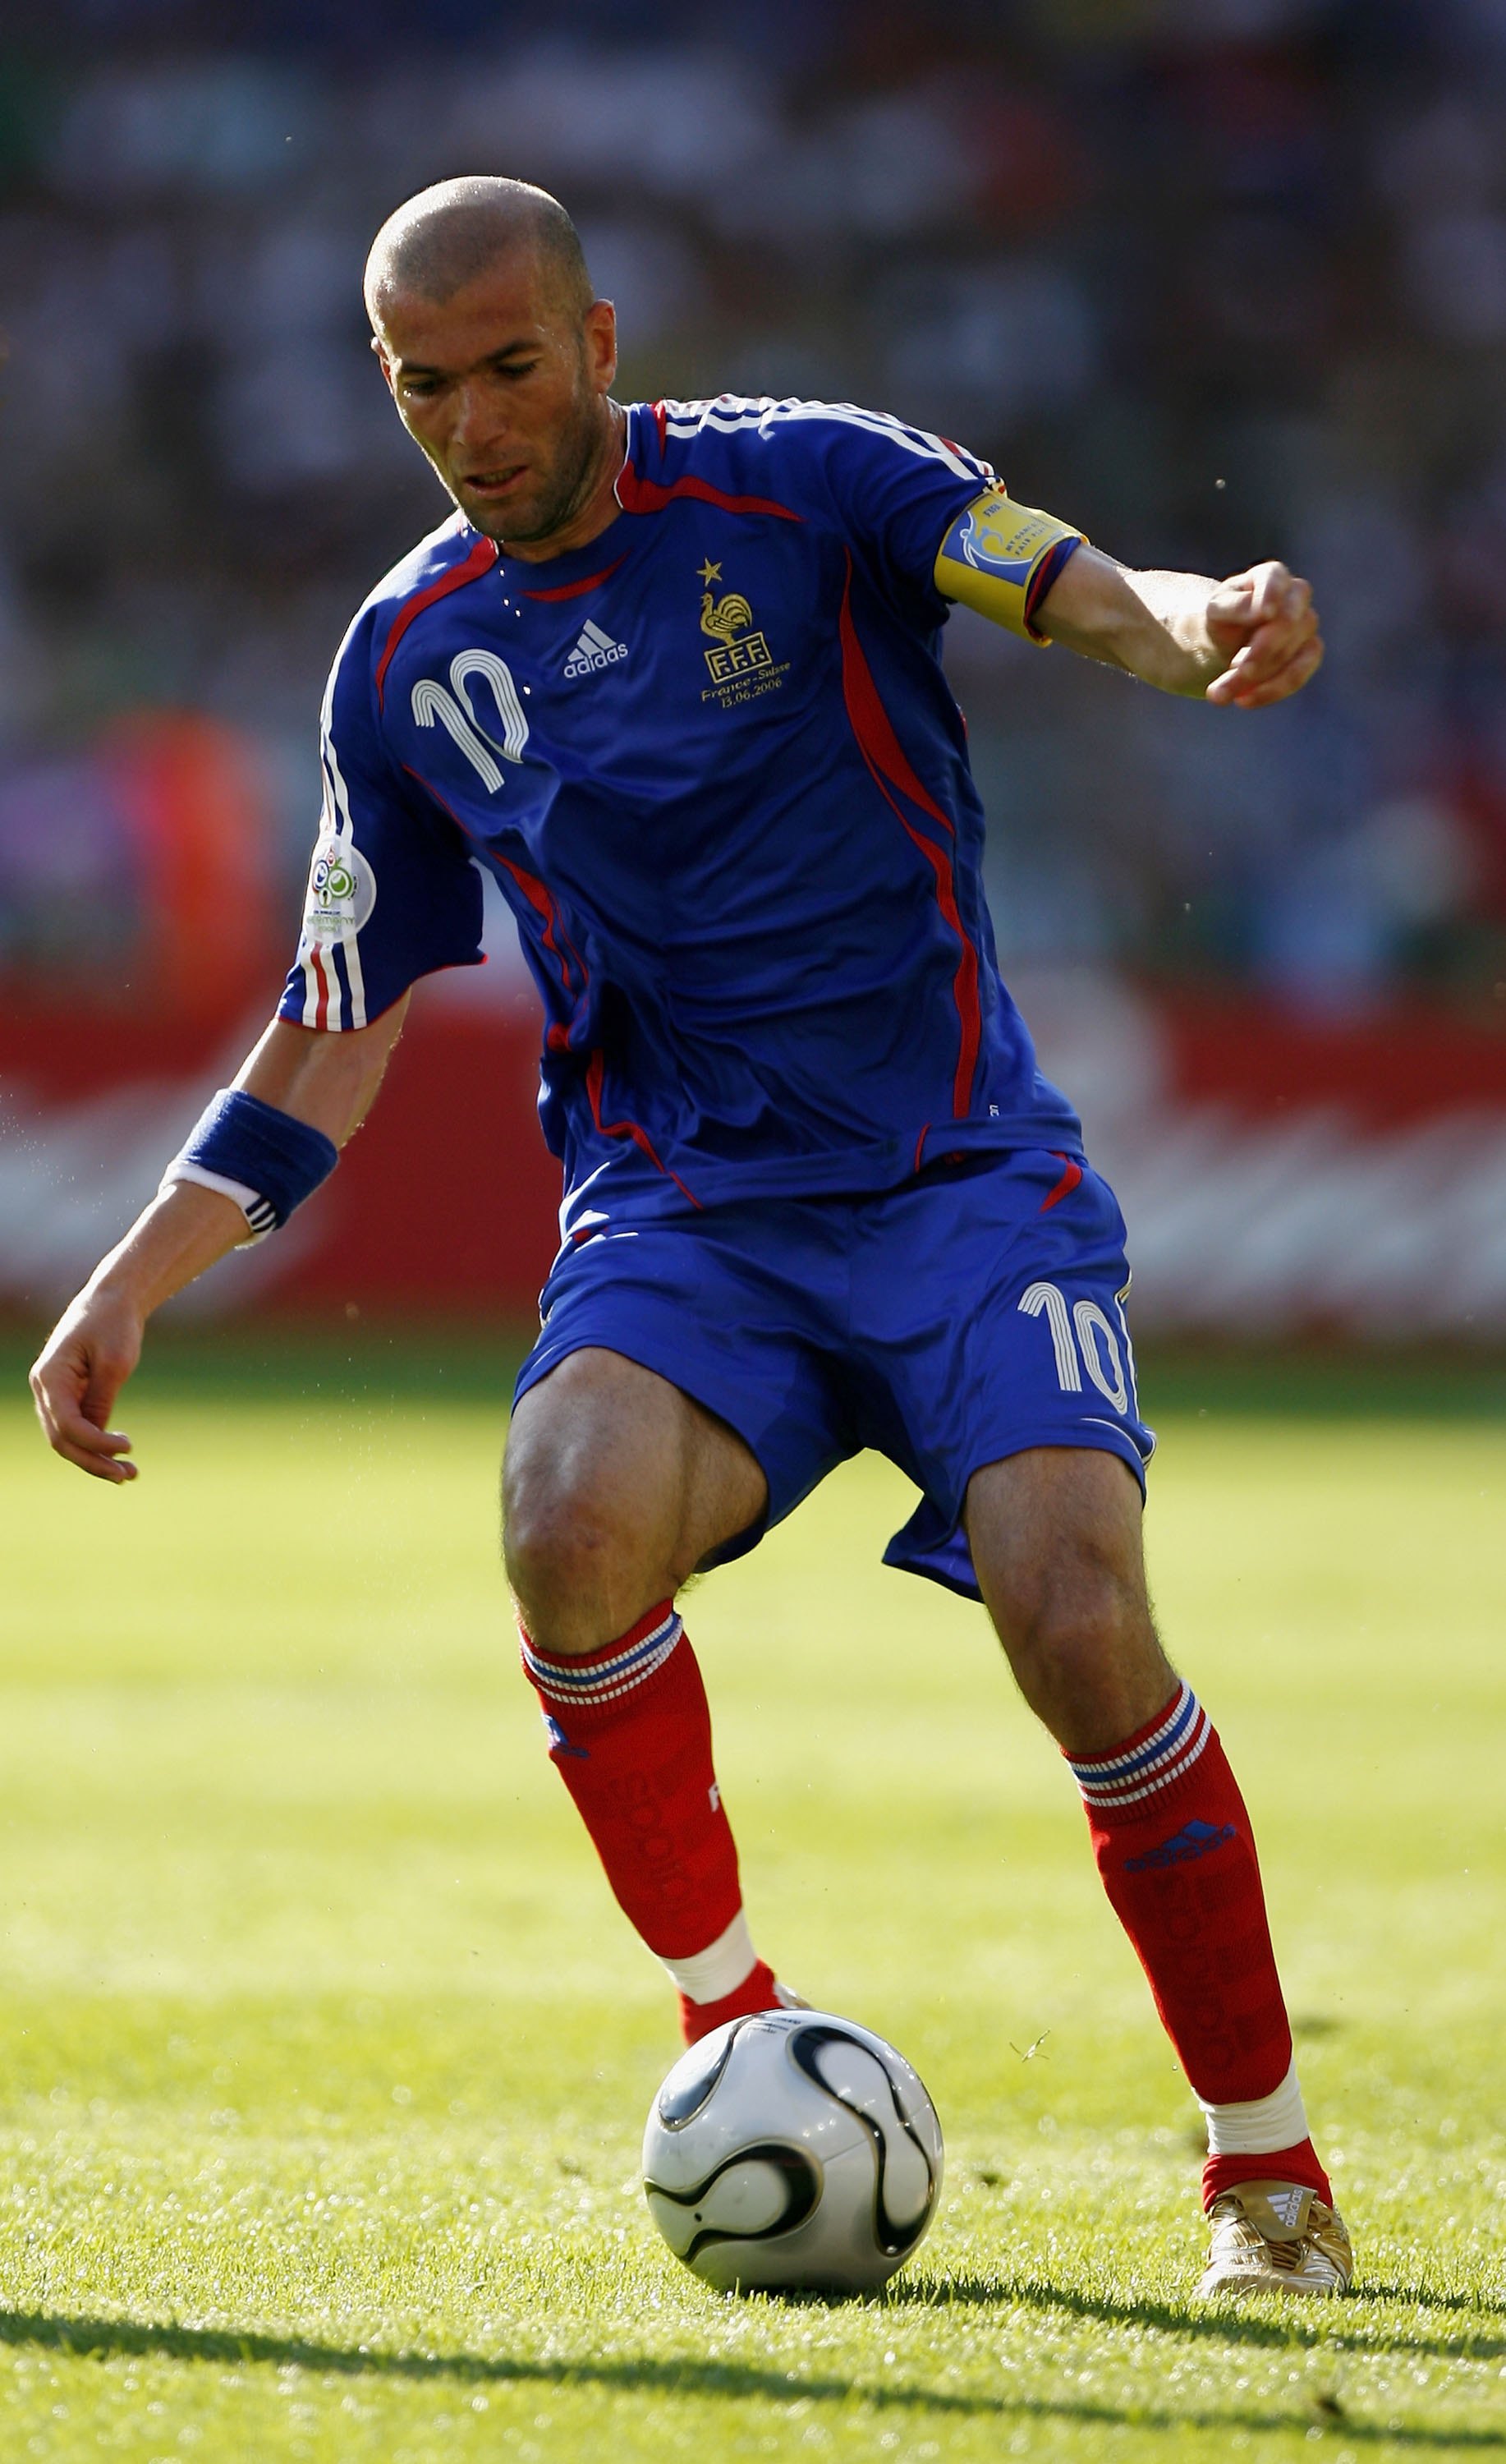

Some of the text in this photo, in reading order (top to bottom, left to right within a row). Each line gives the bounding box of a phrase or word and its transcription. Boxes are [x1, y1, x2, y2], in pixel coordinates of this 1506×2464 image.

[563, 643, 628, 678] adidas
[721, 676, 783, 708] 13.06.2006
[411, 648, 530, 794] 10
[1017, 1281, 1128, 1415] 10
[1284, 2189, 1304, 2227] adidas
